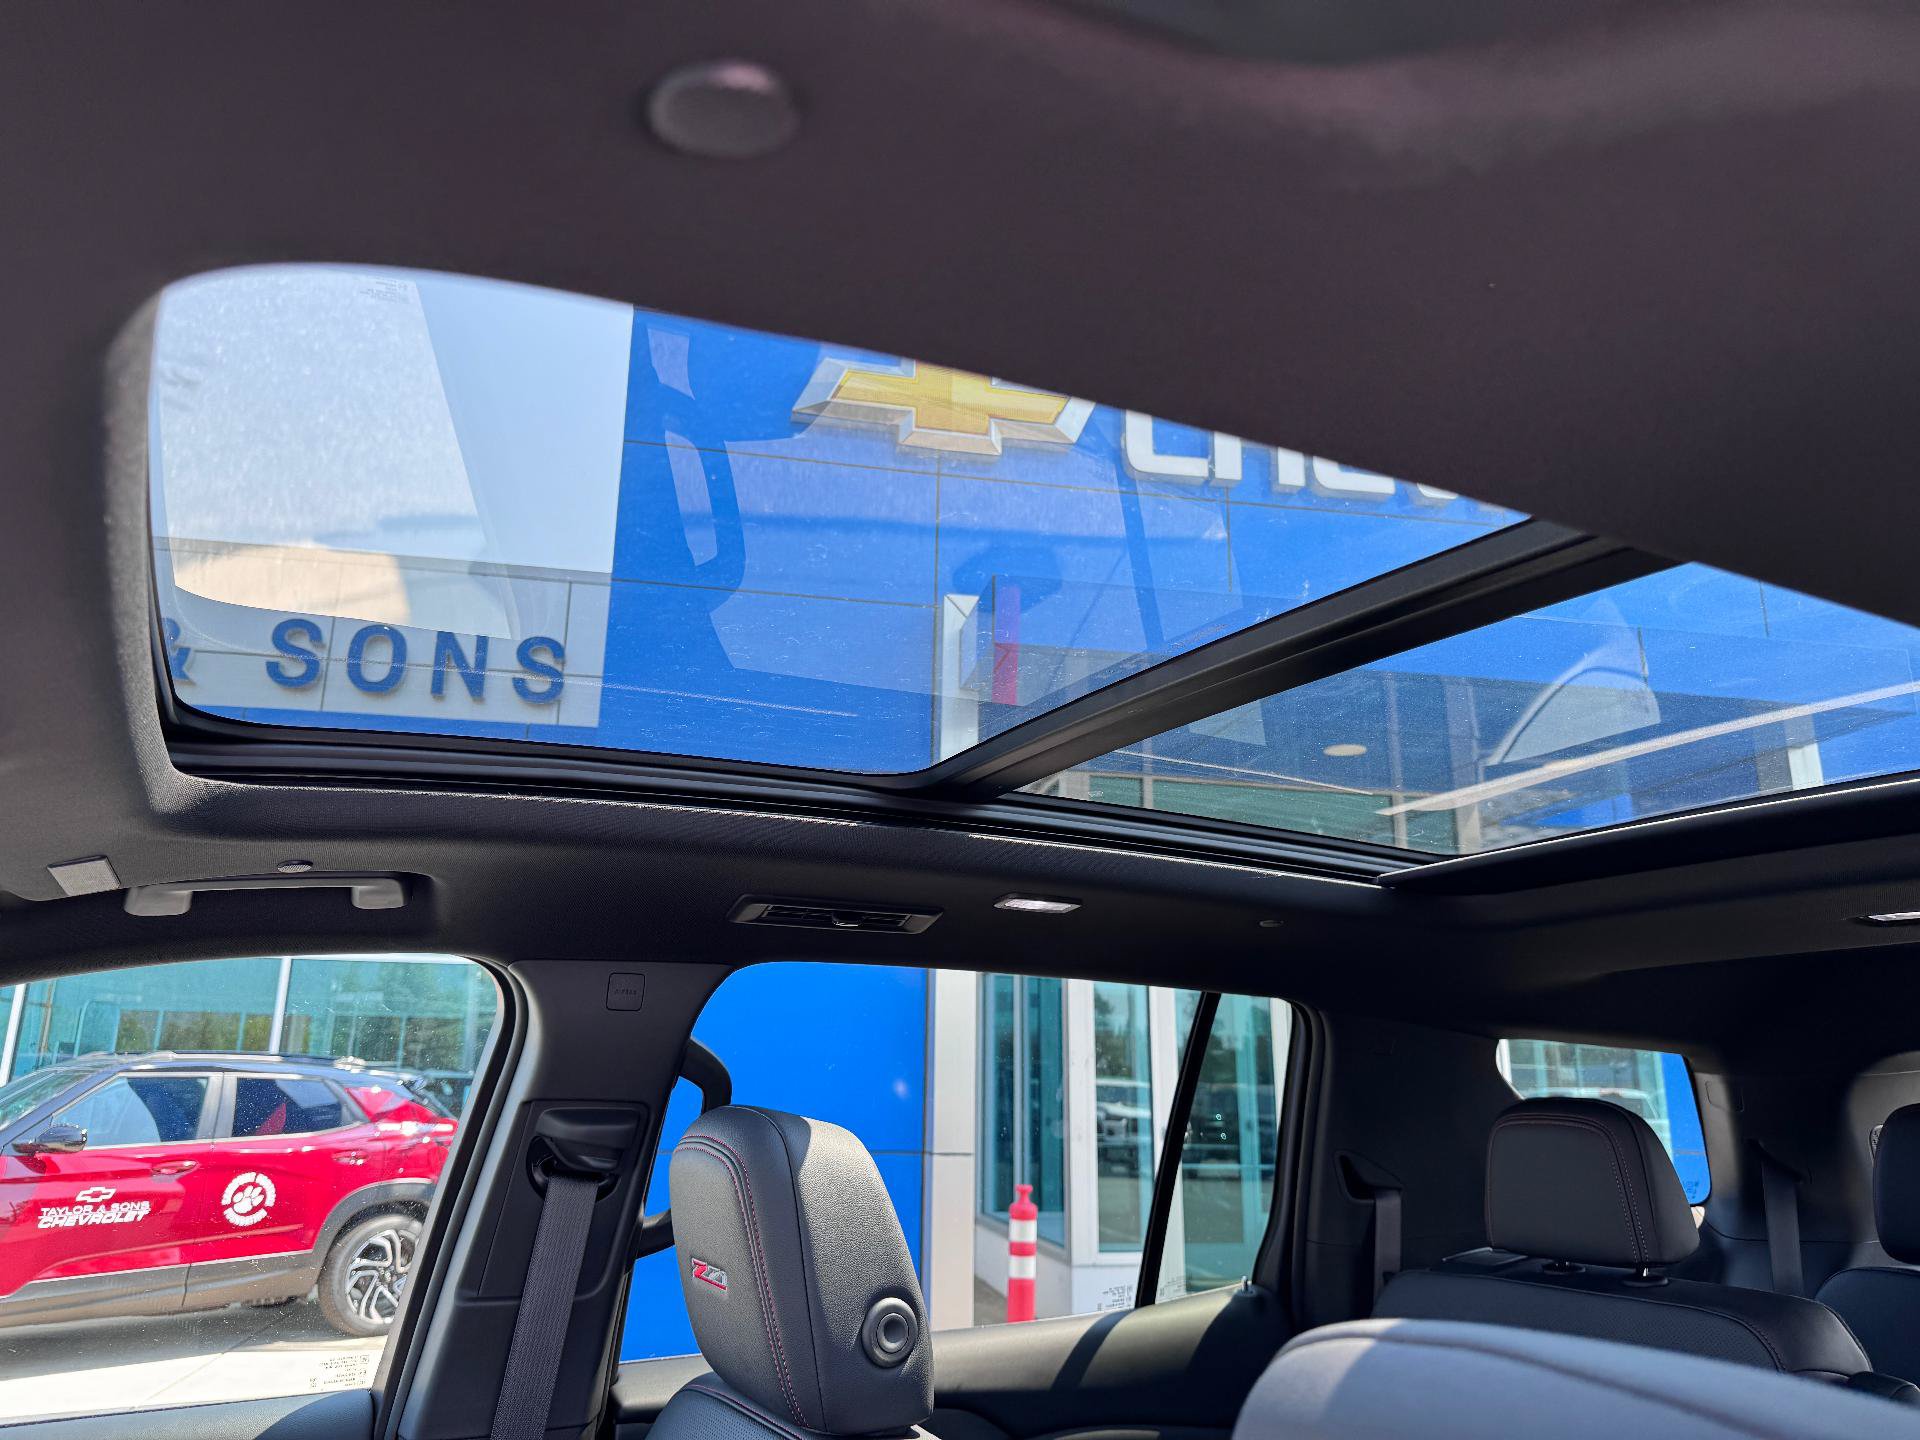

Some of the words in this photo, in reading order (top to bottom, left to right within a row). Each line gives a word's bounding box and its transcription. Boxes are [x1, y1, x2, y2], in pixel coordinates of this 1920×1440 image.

[266, 618, 566, 703] SONS
[37, 1209, 151, 1228] CHEVROLET
[40, 1204, 93, 1217] TAYLOR
[111, 1200, 150, 1212] SONS
[692, 1257, 728, 1291] Z71
